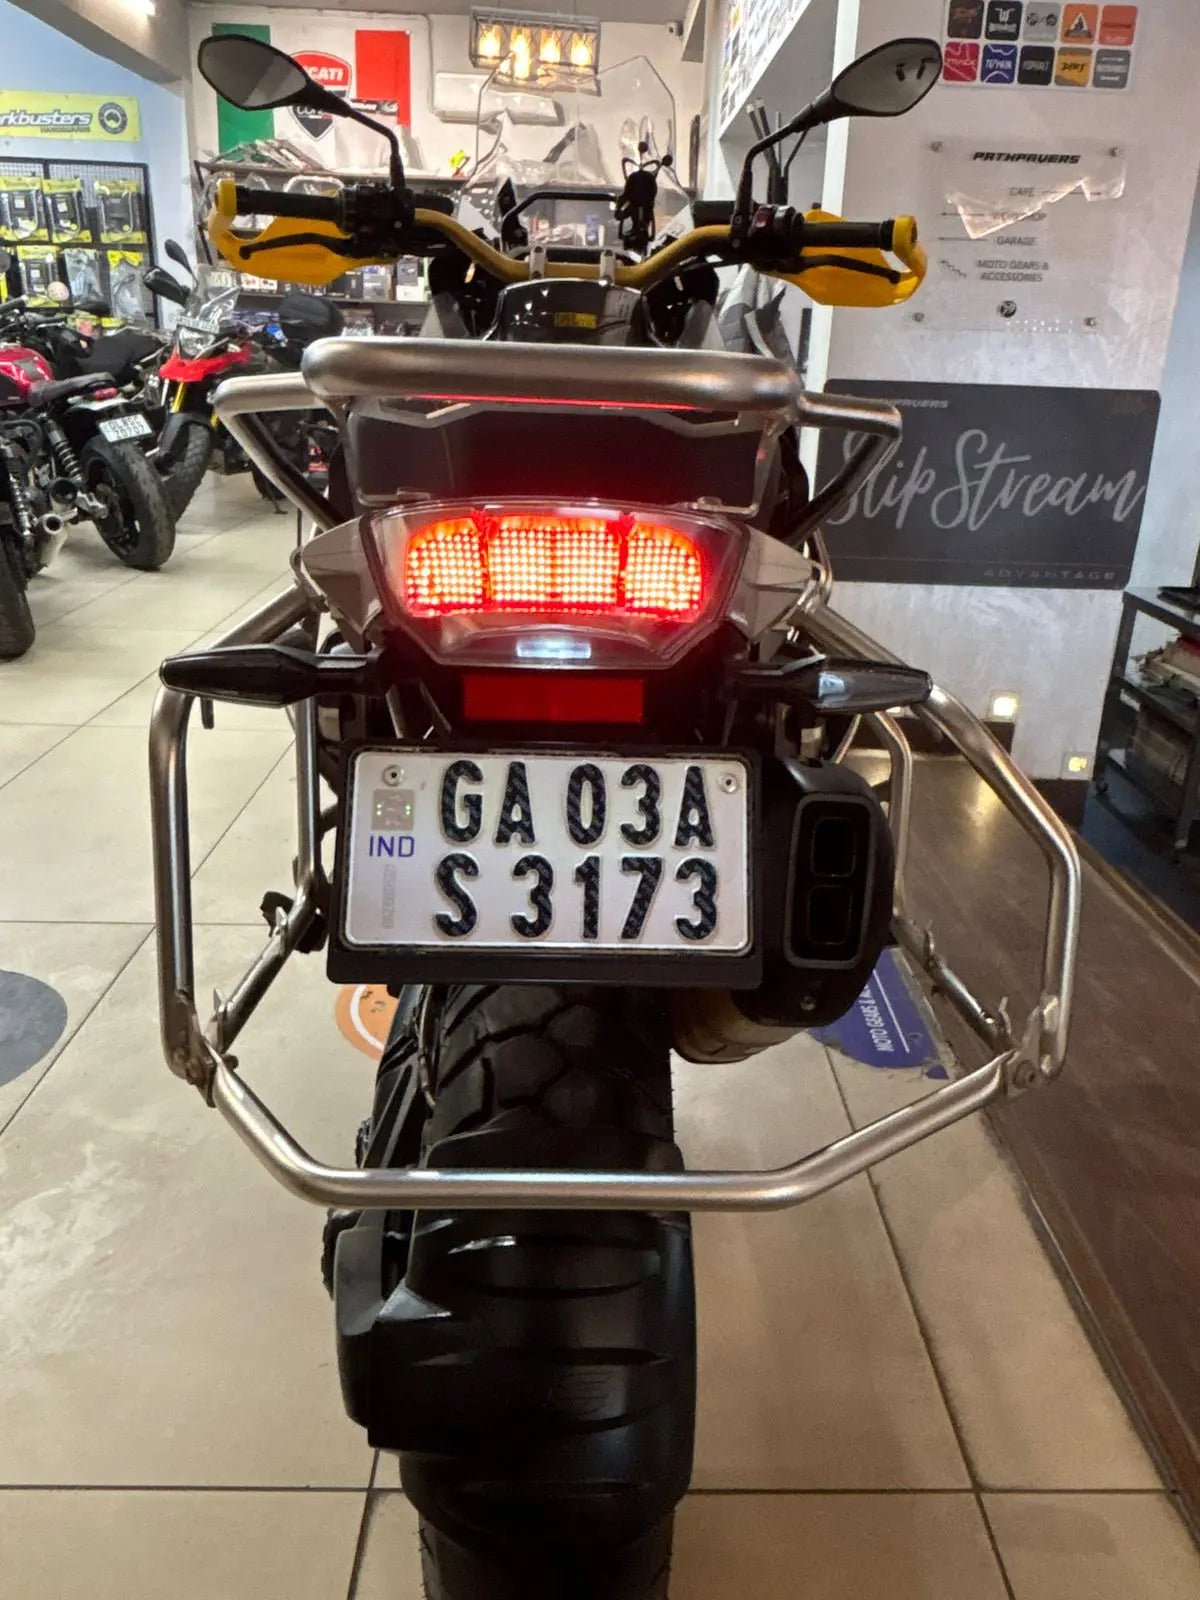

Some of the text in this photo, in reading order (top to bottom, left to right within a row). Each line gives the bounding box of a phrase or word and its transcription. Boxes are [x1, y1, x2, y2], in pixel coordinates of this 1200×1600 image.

[304, 65, 344, 82] CATI
[0, 109, 92, 126] rkbusters
[973, 152, 1081, 164] PATHPAVERS
[996, 236, 1037, 246] GARAGE
[977, 260, 1008, 269] MOTO
[981, 272, 1043, 282] ACCESSORIES
[983, 568, 1116, 582] ADVANTAGE
[440, 759, 715, 849] GA 03A
[369, 836, 415, 858] IND
[433, 853, 481, 938] S
[510, 854, 719, 941] 3173
[869, 1028, 895, 1052] MOTO
